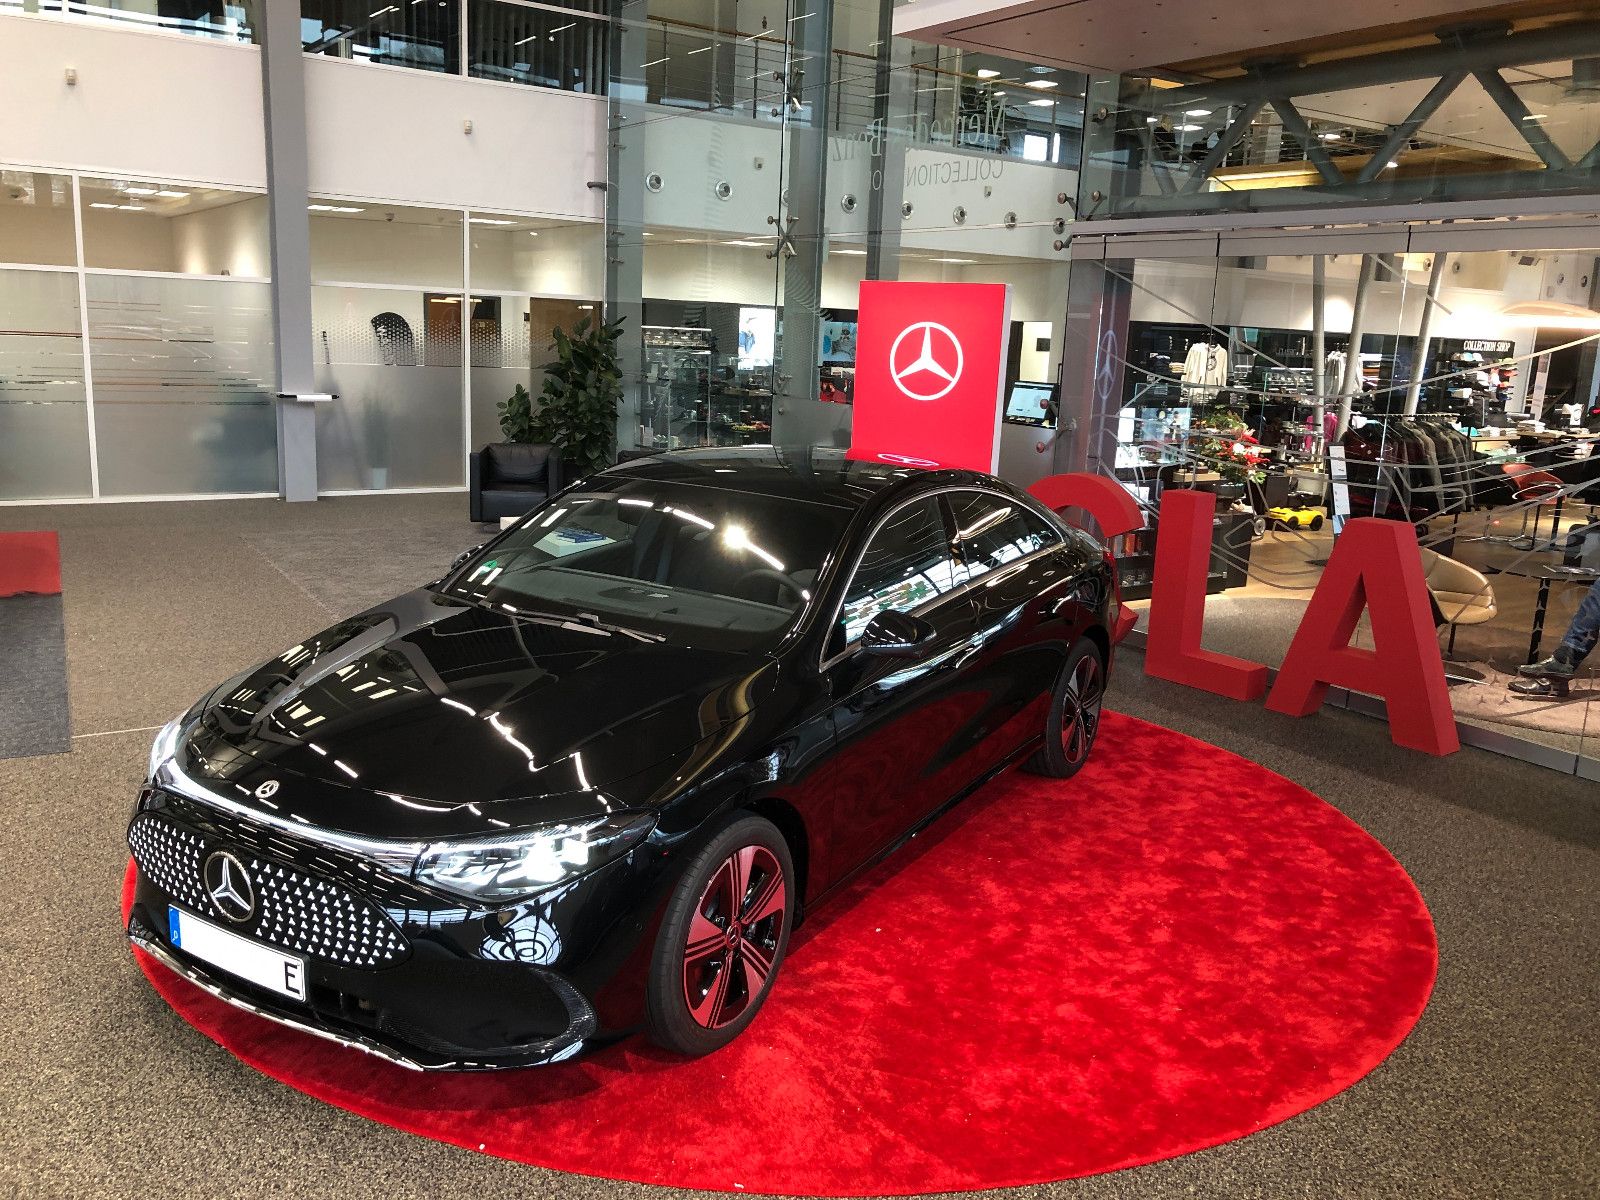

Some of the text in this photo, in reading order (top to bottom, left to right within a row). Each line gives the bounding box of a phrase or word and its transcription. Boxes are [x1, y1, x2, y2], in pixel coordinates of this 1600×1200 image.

[1463, 340, 1511, 352] COLLECTION SHOP
[284, 961, 300, 994] E
